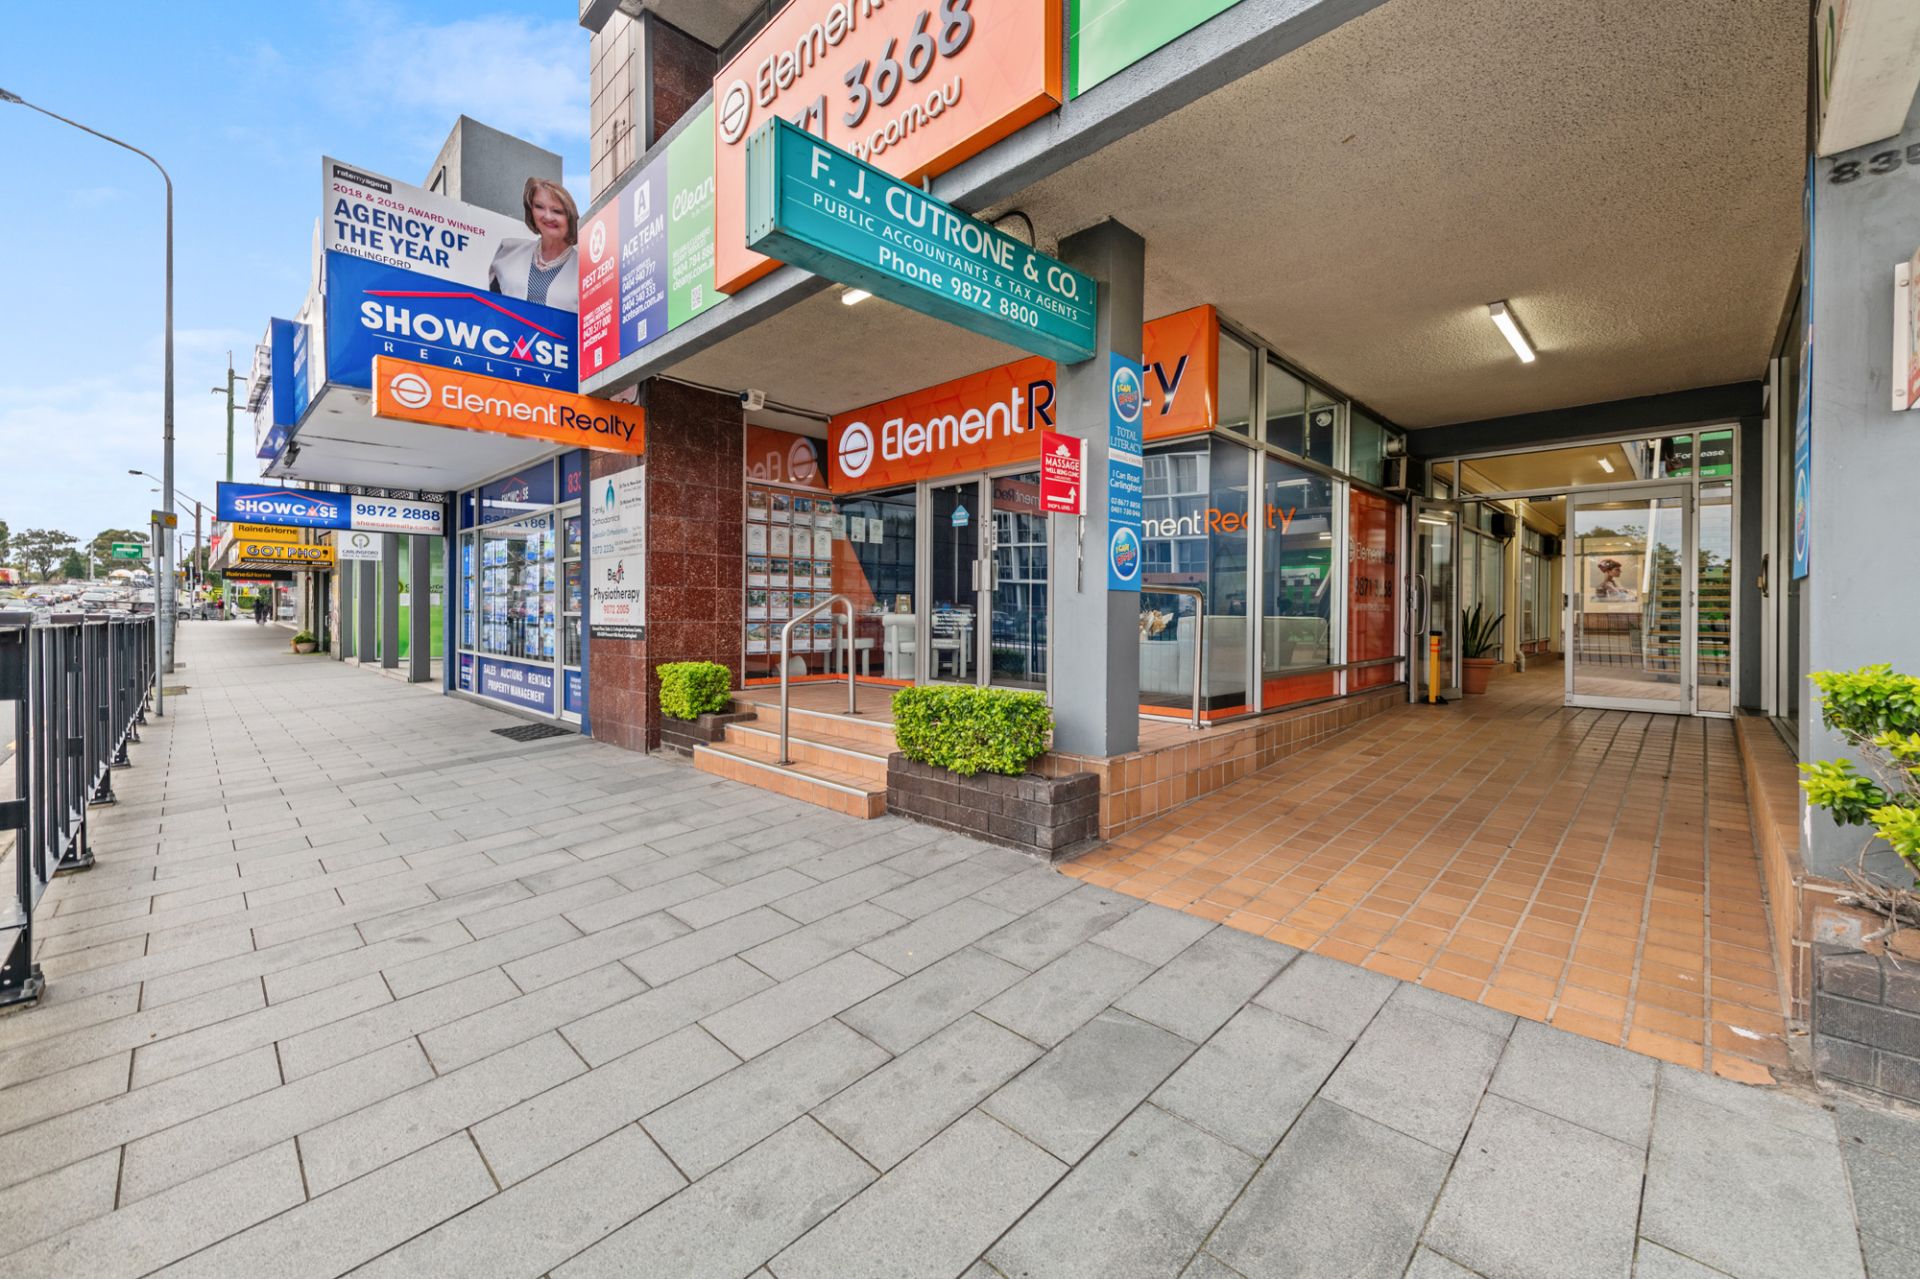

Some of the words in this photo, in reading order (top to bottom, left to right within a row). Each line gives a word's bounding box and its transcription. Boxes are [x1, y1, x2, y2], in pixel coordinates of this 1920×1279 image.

[844, 0, 974, 128] 3668
[337, 169, 389, 191] ratemyagent
[333, 183, 362, 199] 2018
[366, 194, 375, 203] &
[377, 196, 405, 212] 2019
[407, 206, 444, 224] AWARD
[447, 218, 486, 237] WINNER
[334, 198, 435, 243] AGENCY
[441, 230, 470, 252] OF
[811, 145, 835, 187] F.
[848, 170, 871, 204] J.
[885, 186, 1015, 271] CUTRONE
[1023, 254, 1039, 283] &
[1047, 266, 1079, 302] CO.
[334, 219, 384, 251] THE
[389, 235, 450, 269] YEAR
[622, 234, 638, 261] ACE
[639, 213, 664, 246] TEAM
[335, 243, 412, 269] CARLINGFORD
[813, 193, 875, 233] PUBLIC
[883, 225, 988, 281] ACCOUNTANTS
[995, 275, 1003, 288] &
[1008, 280, 1031, 301] TAX
[1036, 293, 1078, 321] AGENTS
[582, 268, 596, 292] PEST
[597, 255, 615, 280] ZERO
[879, 245, 943, 290] Phone
[950, 277, 992, 309] 9872
[999, 298, 1038, 328] 8800
[361, 300, 569, 369] SHOWCASE
[384, 341, 551, 383] REALTY
[442, 384, 636, 442] ElementRealty
[1110, 435, 1142, 454] LITERACY
[1116, 425, 1138, 442] TOTAL
[1045, 456, 1080, 471] MASSAGE
[1675, 451, 1693, 460] For
[1700, 449, 1725, 459] ease
[1045, 466, 1056, 474] WELL
[1116, 470, 1126, 480] Can
[1110, 478, 1142, 494] Carlingford
[234, 499, 338, 519] SHOWCASE
[356, 503, 397, 518] 9872
[402, 507, 441, 522] 2888
[247, 544, 284, 557] GOT
[593, 585, 641, 604] Physiotherapy
[483, 663, 496, 677] SALES
[501, 667, 523, 682] AUCTIONS
[528, 672, 551, 688] RENTALS
[487, 679, 510, 695] PROPERTY
[510, 685, 545, 704] MANAGEMENT
